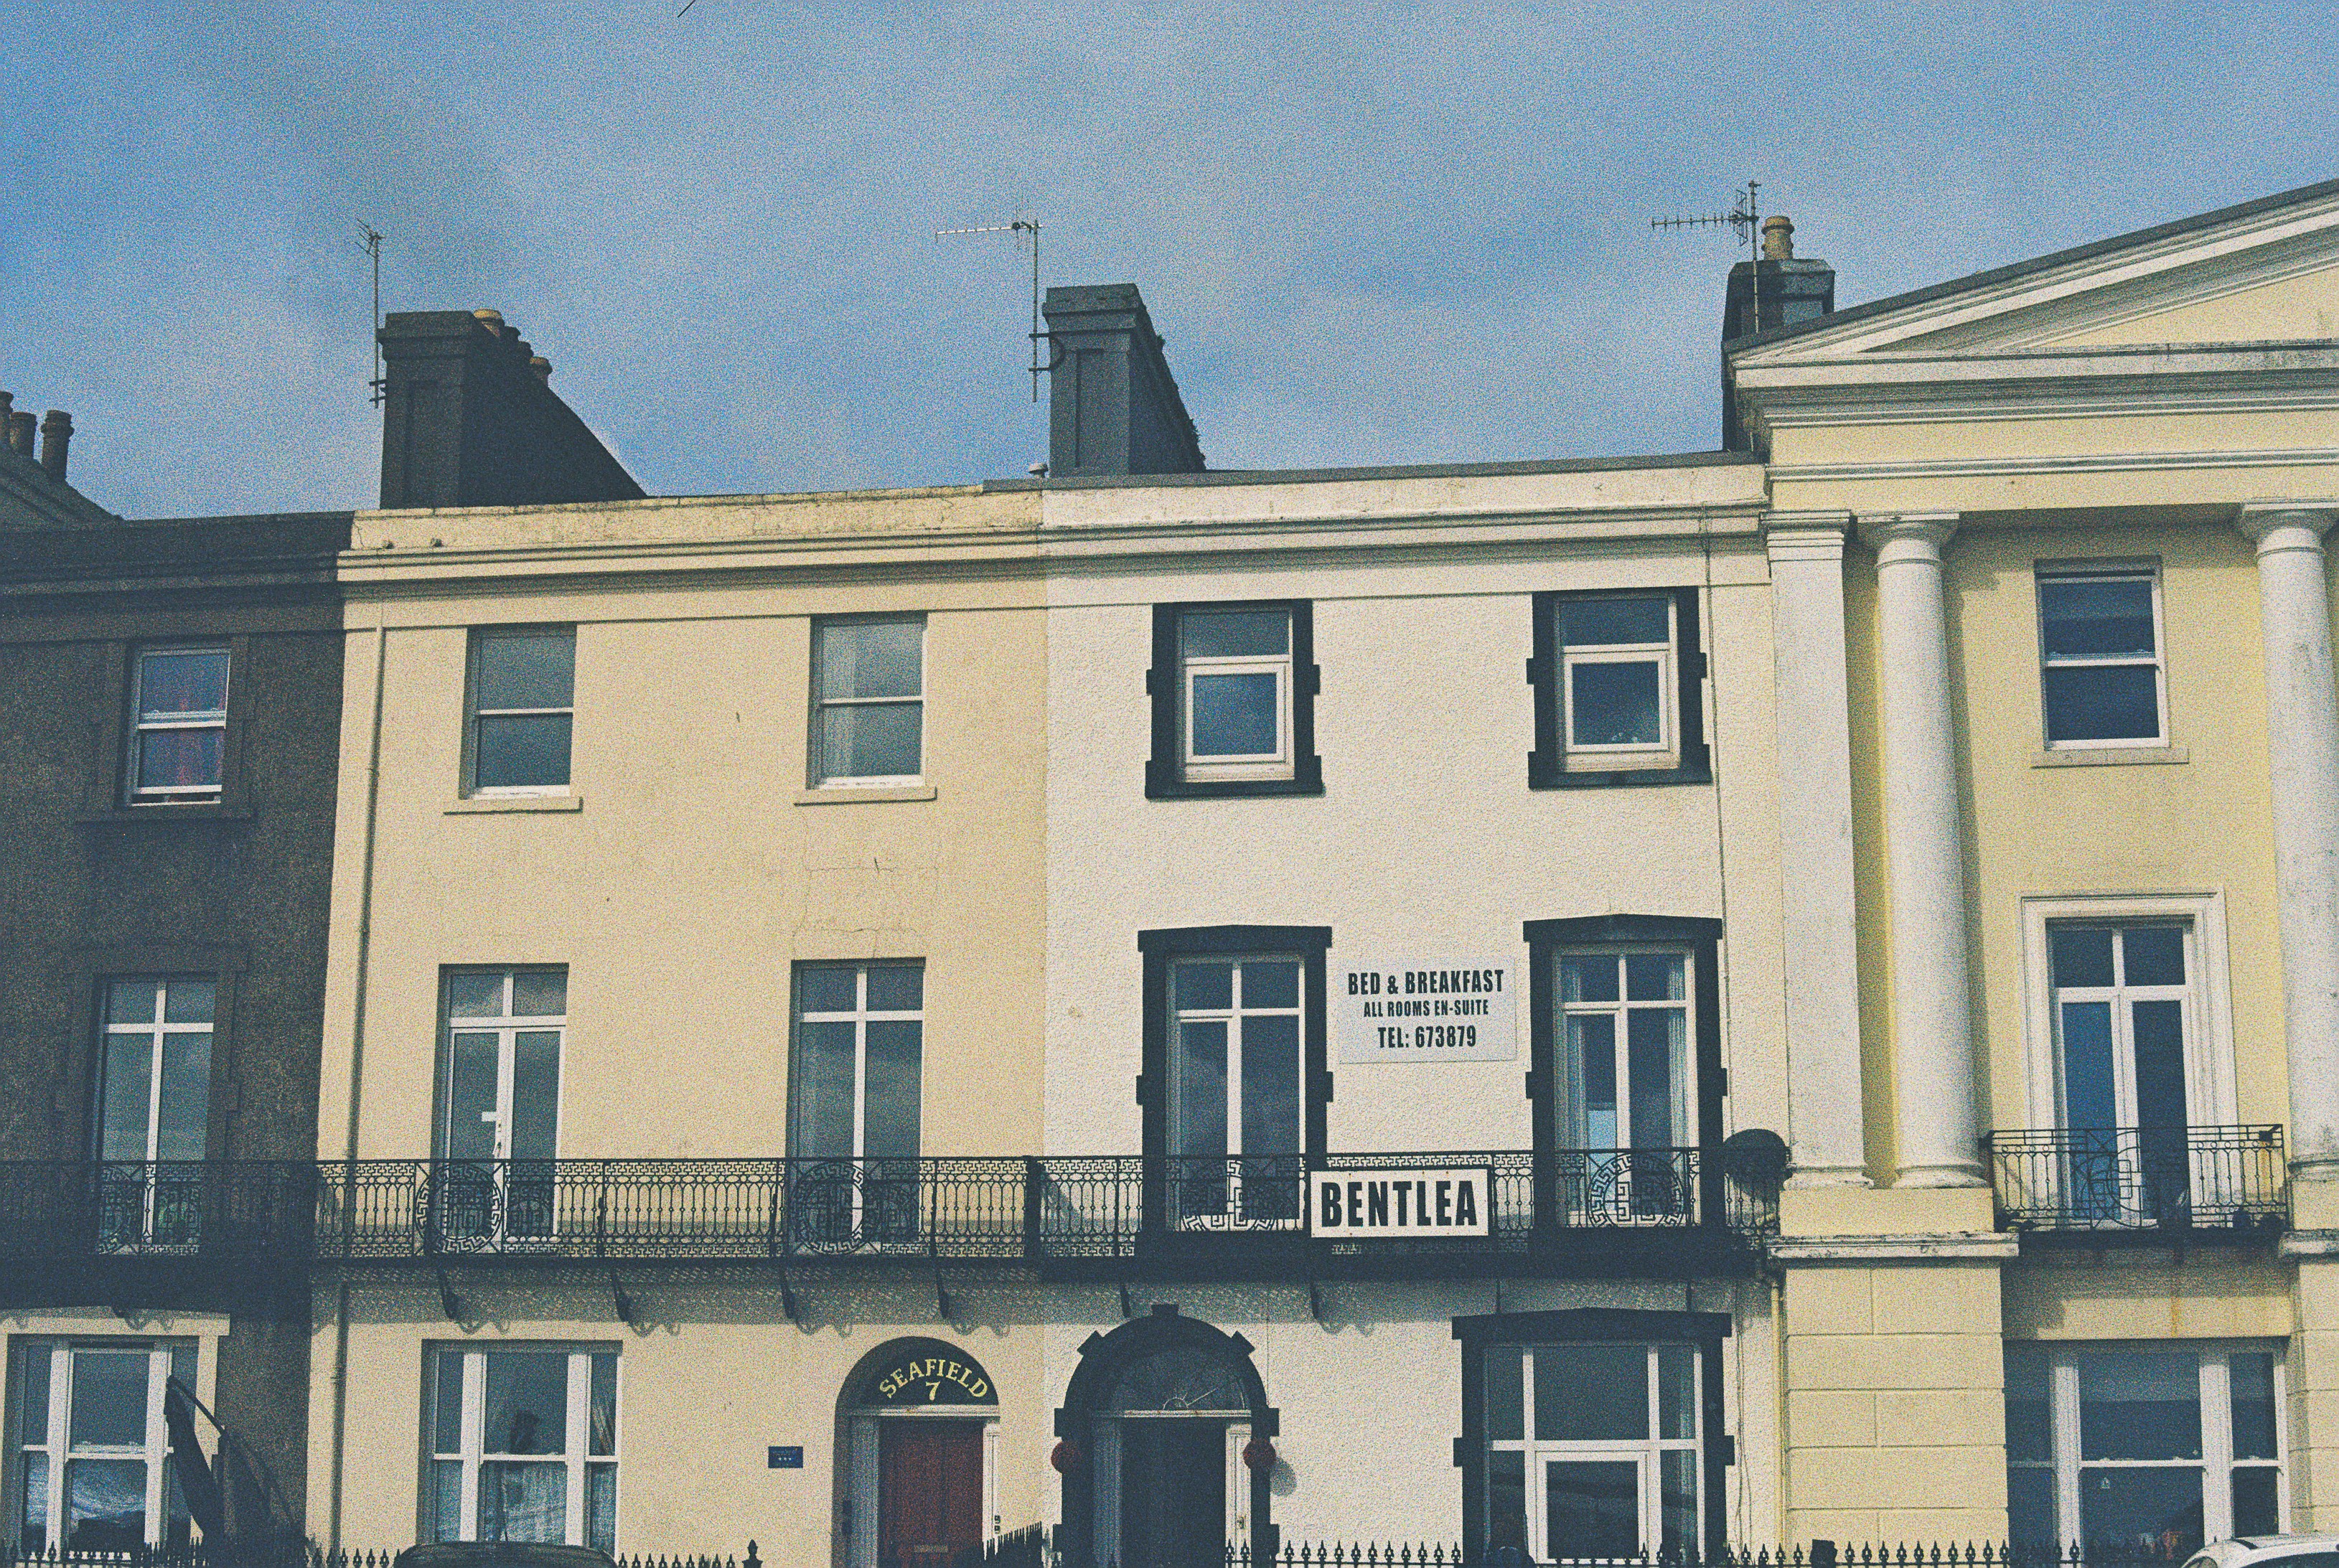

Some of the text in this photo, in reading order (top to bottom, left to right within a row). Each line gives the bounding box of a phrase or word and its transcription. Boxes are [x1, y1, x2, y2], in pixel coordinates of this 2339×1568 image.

[1348, 970, 1504, 995] BED & BREAKFAST
[1364, 998, 1489, 1018] ALL ROOMS EN-SUITE
[1378, 1025, 1476, 1048] TEL: 673879
[1321, 1180, 1478, 1227] BENTLEA
[879, 1358, 988, 1399] SEAFIELD
[925, 1381, 941, 1401] 7
